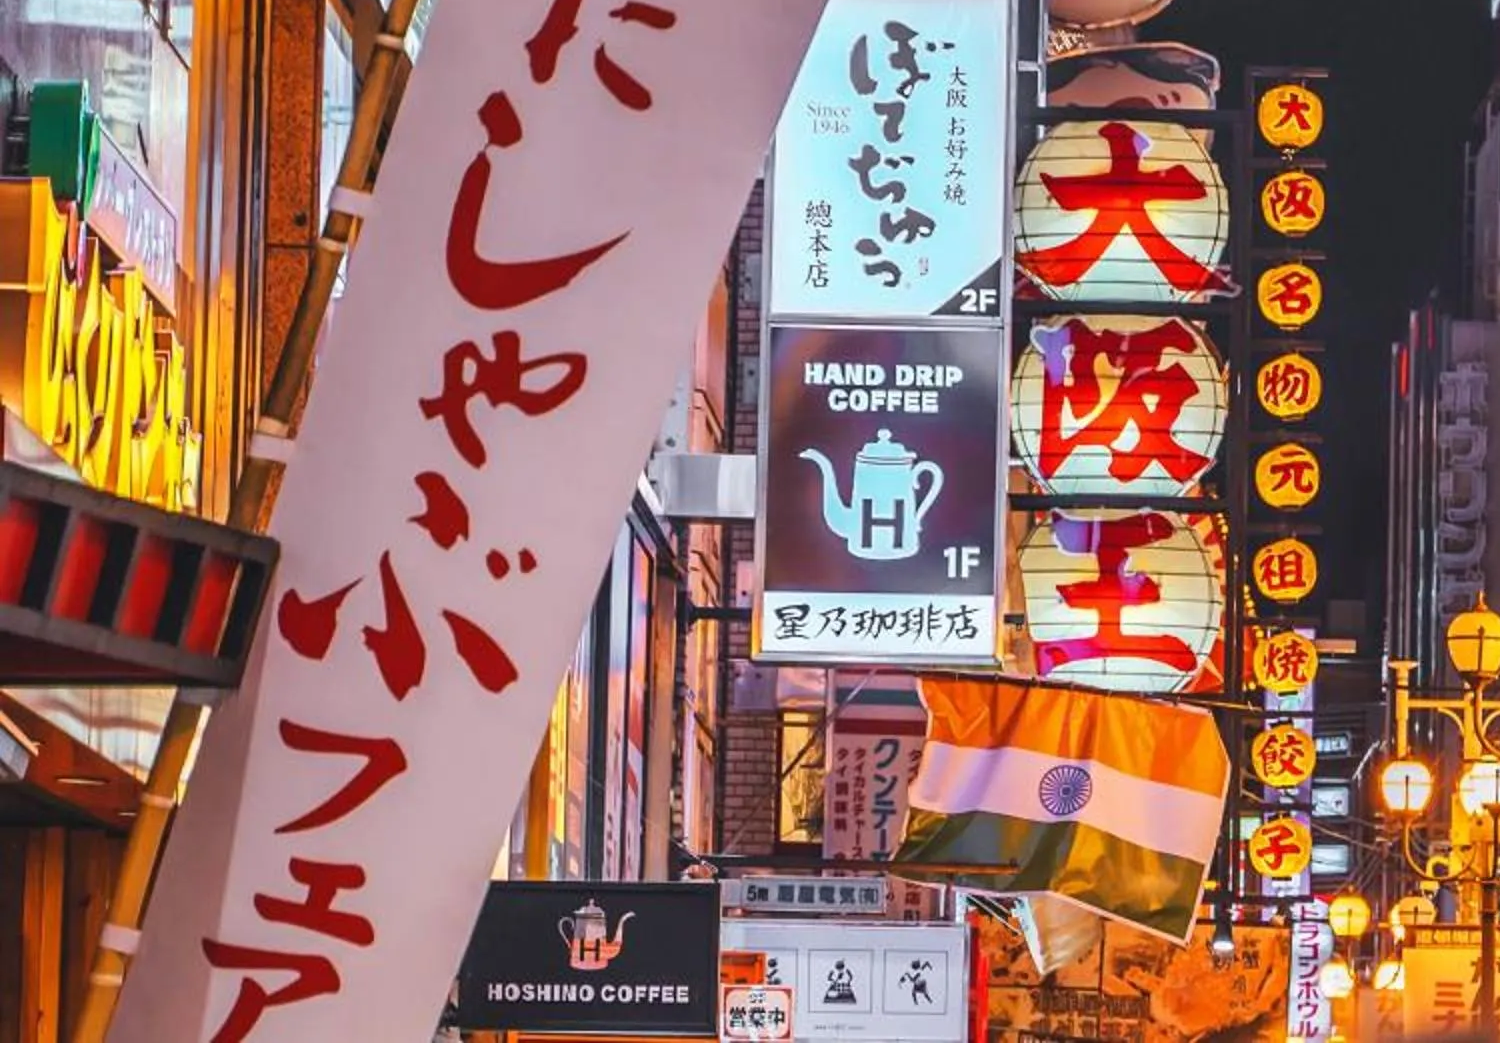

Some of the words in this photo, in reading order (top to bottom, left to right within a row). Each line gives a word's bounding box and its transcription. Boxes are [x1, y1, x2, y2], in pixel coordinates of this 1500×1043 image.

[945, 66, 969, 109] 大阪
[805, 100, 851, 118] Since
[943, 116, 968, 206] お好み焼
[959, 290, 997, 313] 2F
[804, 362, 886, 386] HAND
[895, 364, 964, 387] DRIP
[827, 389, 940, 413] COFFEE
[861, 498, 905, 550] H
[943, 546, 981, 579] 1F
[774, 602, 981, 644] 星乃珈琲店
[580, 938, 601, 961] H
[488, 983, 595, 1003] HOSHINO
[601, 985, 690, 1004] COFFEE
